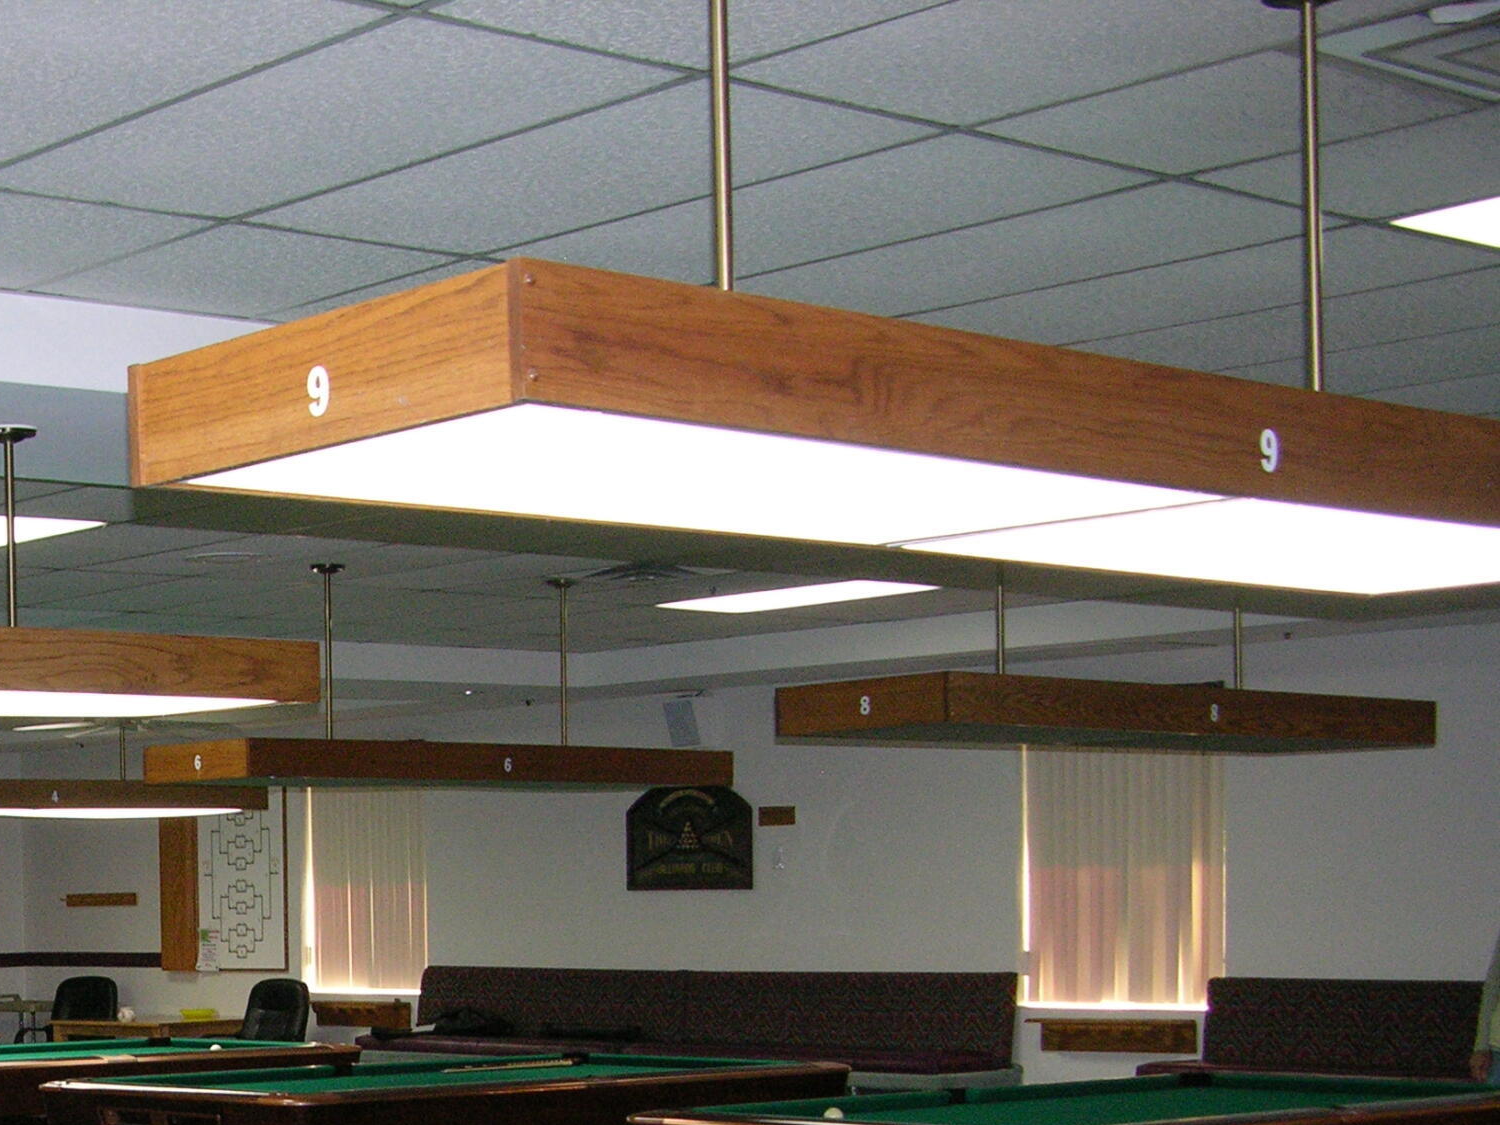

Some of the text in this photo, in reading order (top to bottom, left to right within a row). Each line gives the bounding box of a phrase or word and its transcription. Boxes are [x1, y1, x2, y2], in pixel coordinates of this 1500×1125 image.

[306, 365, 330, 417] 9
[1260, 428, 1278, 473] 9
[860, 695, 870, 715] 8
[1210, 703, 1219, 722] 8
[194, 754, 202, 770] 6
[504, 757, 512, 773] 6
